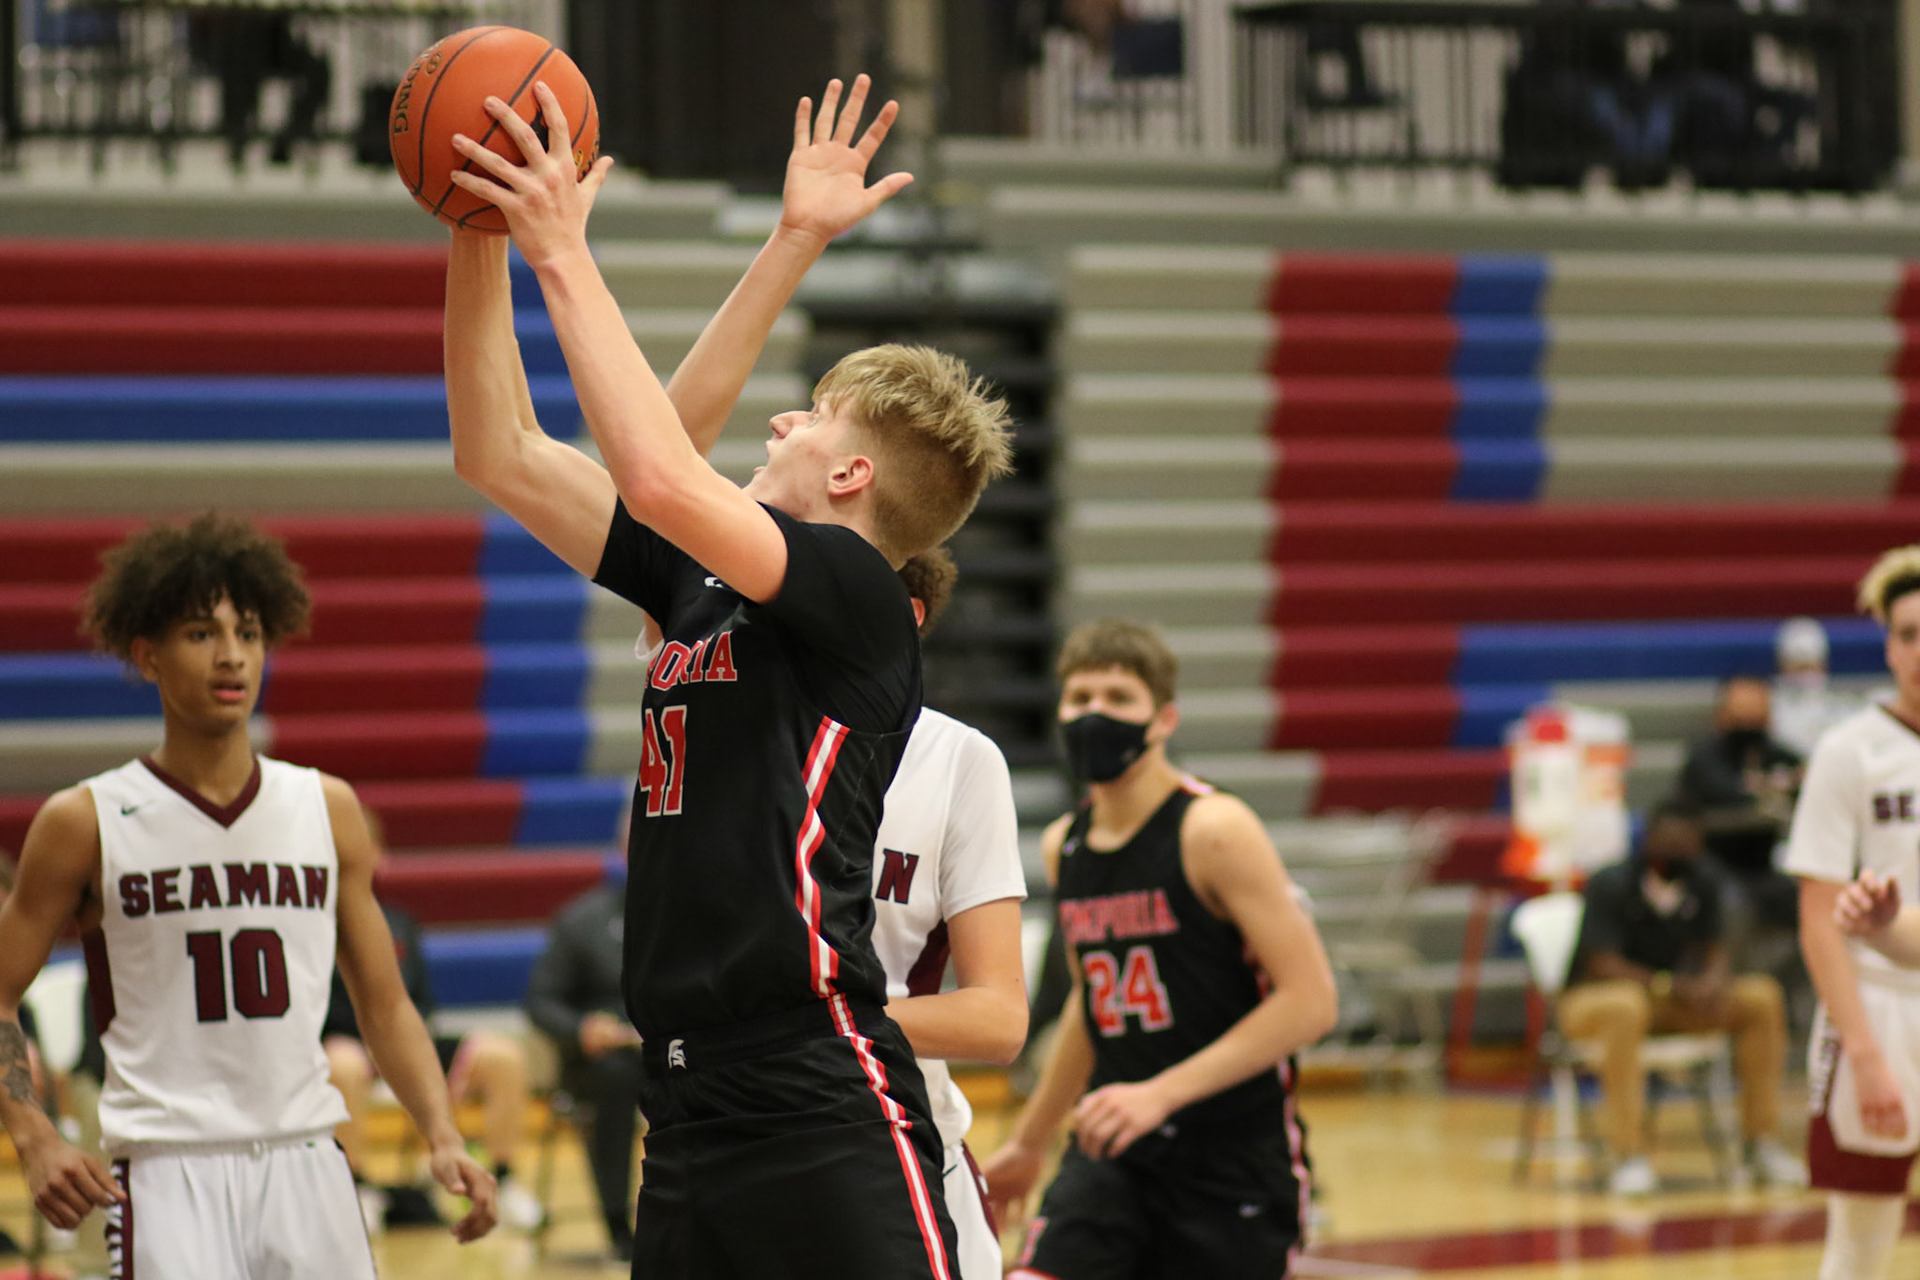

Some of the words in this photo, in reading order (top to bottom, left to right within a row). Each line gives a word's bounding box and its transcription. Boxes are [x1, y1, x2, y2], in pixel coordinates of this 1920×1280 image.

[645, 630, 737, 691] ORIA
[639, 704, 687, 817] 41
[119, 862, 328, 917] SEAMAN
[186, 928, 290, 1022] 10
[1083, 945, 1174, 1037] 24
